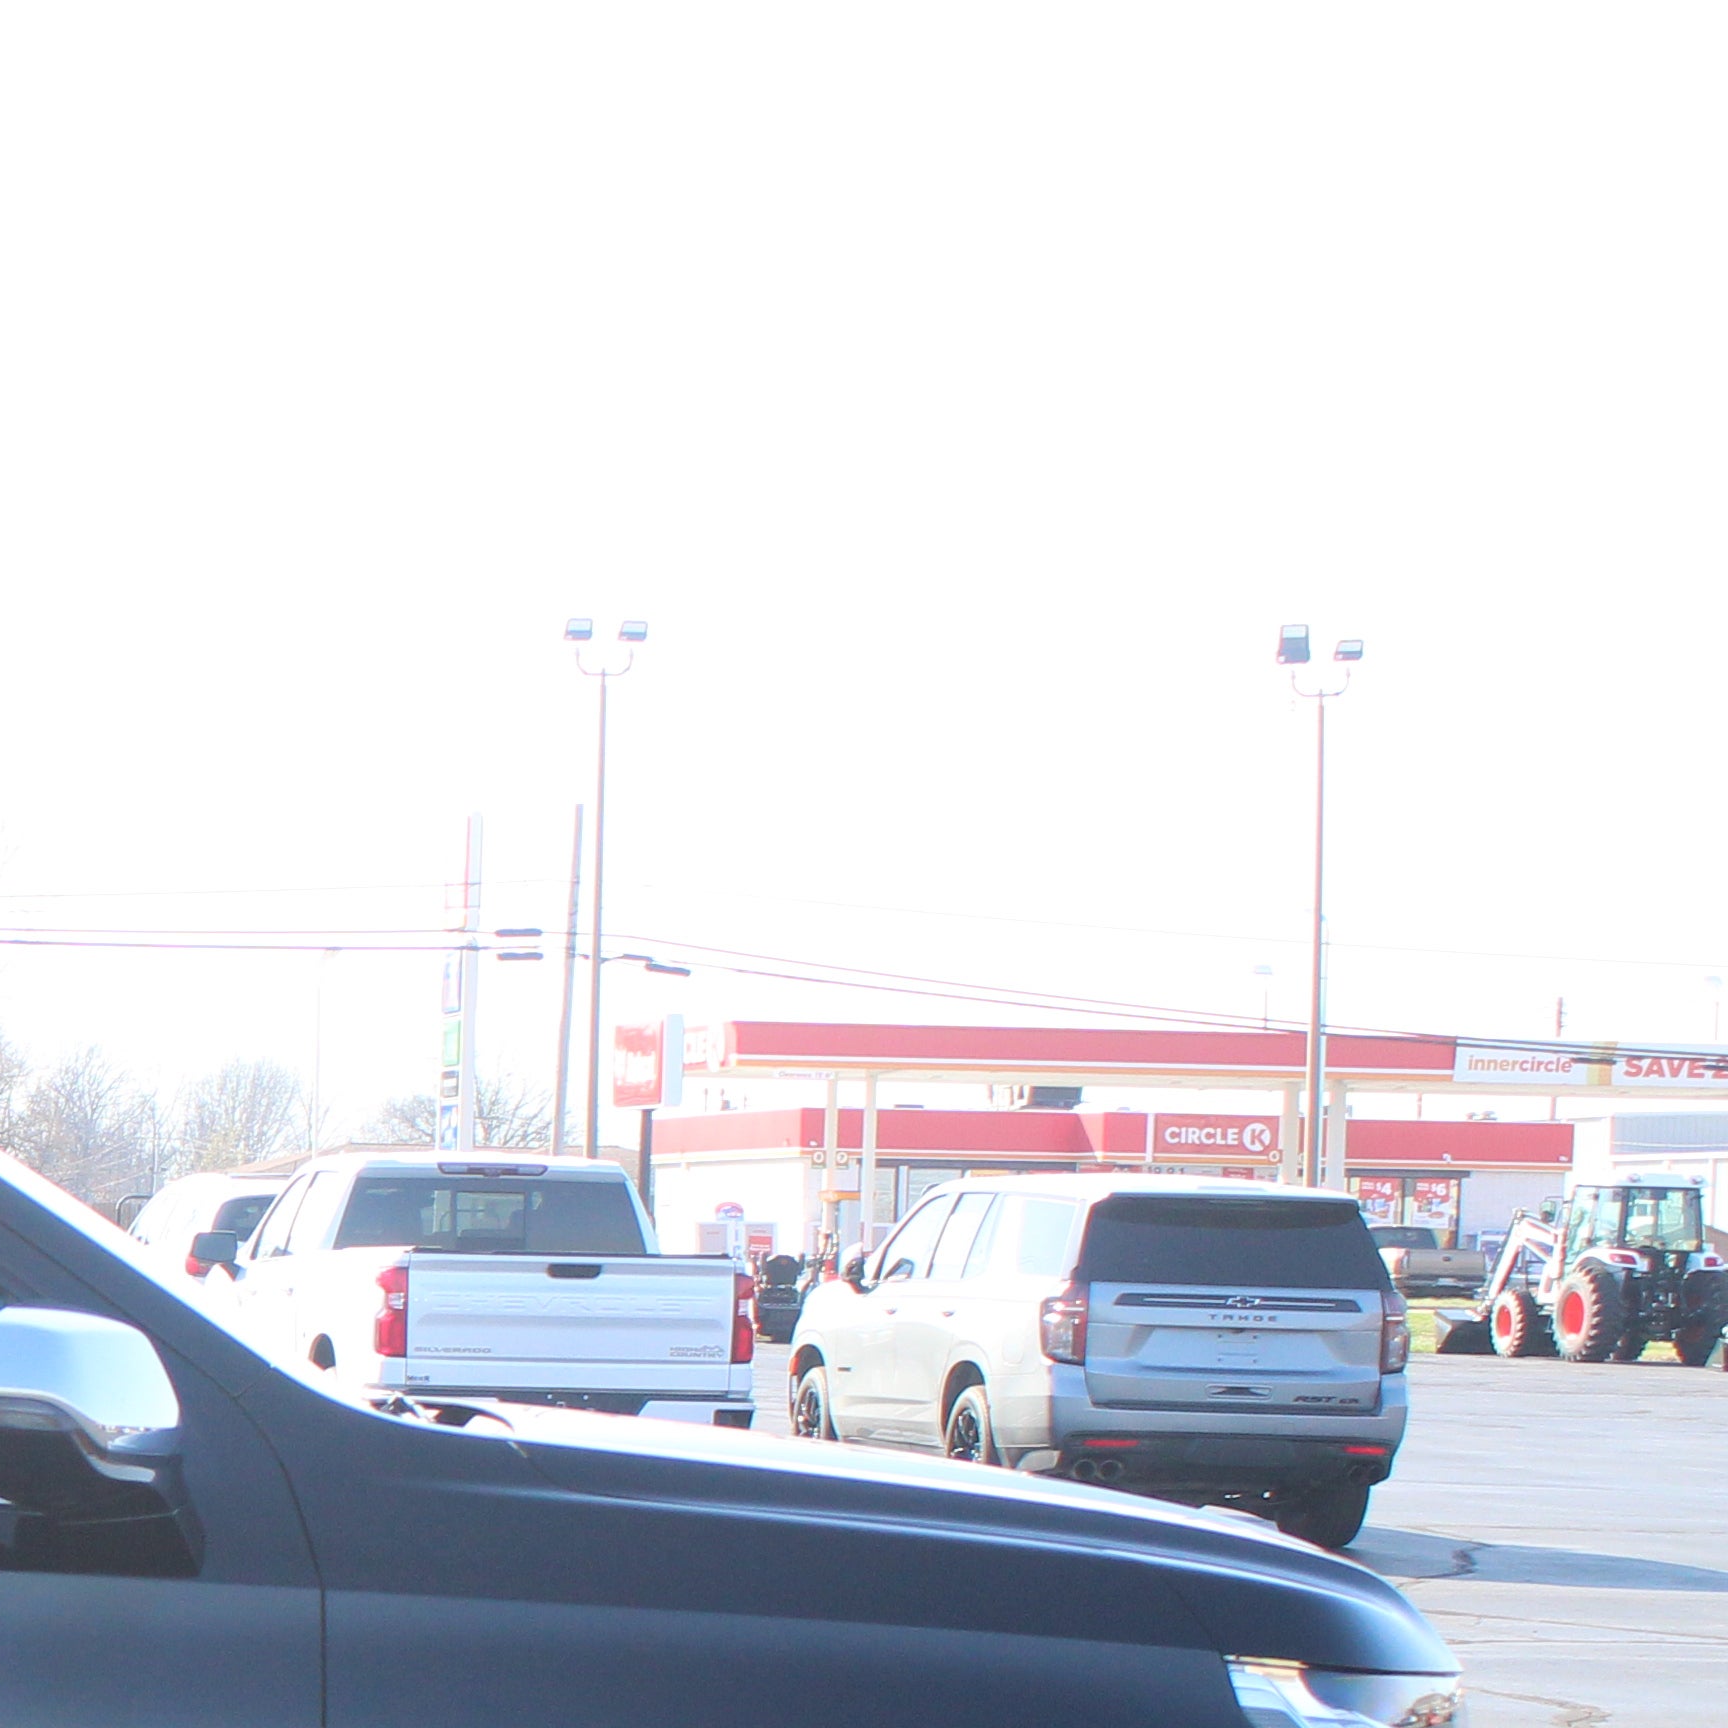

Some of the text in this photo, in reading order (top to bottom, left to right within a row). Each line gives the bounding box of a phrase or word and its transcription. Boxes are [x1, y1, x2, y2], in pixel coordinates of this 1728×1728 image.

[1467, 1055, 1572, 1073] innercircle
[1623, 1057, 1705, 1079] SAVE
[1164, 1125, 1269, 1149] CIRCLE K
[1375, 1182, 1393, 1195] $4
[1430, 1183, 1447, 1196] $6
[429, 1292, 713, 1315] CHEVROLET
[1208, 1313, 1278, 1323] TAHOE
[413, 1345, 492, 1354] SILVERADO
[1292, 1395, 1337, 1404] RST
